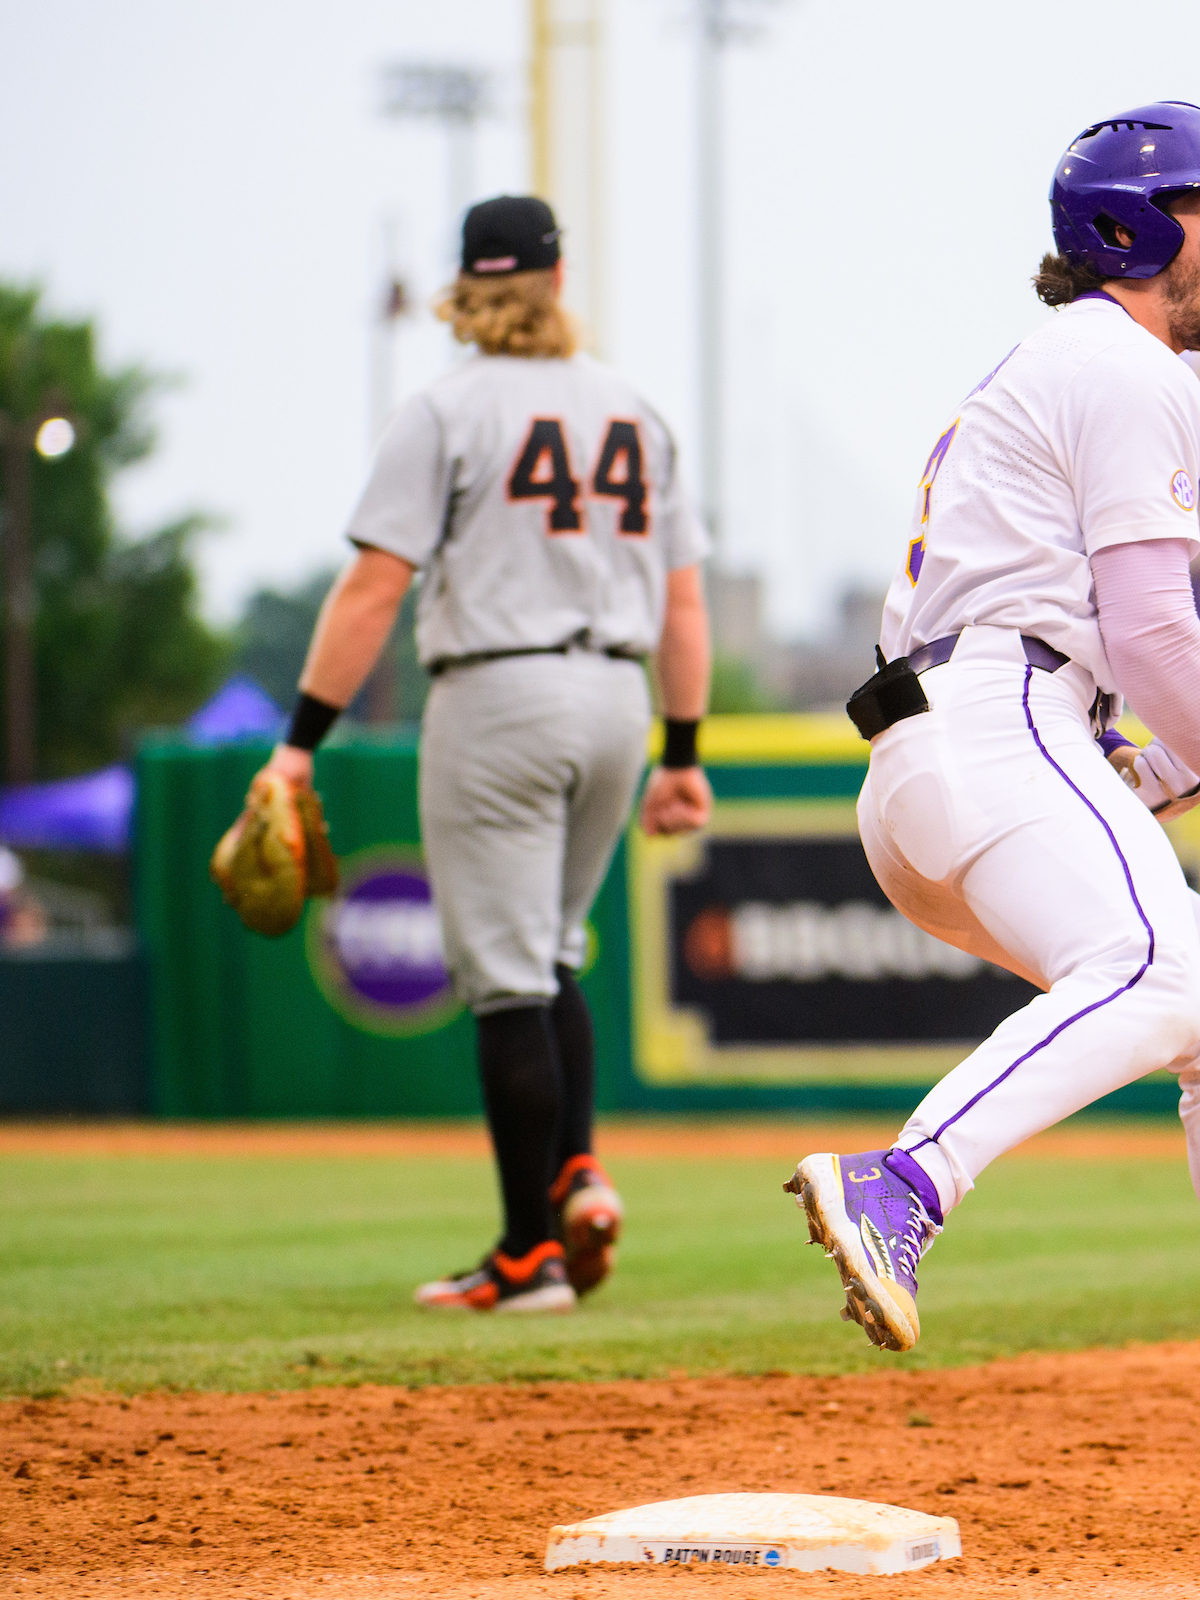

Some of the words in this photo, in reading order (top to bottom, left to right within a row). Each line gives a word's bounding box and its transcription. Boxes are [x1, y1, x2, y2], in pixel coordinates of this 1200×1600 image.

[506, 415, 655, 538] 44
[848, 1167, 882, 1183] 3
[713, 1549, 760, 1565] ROUGE
